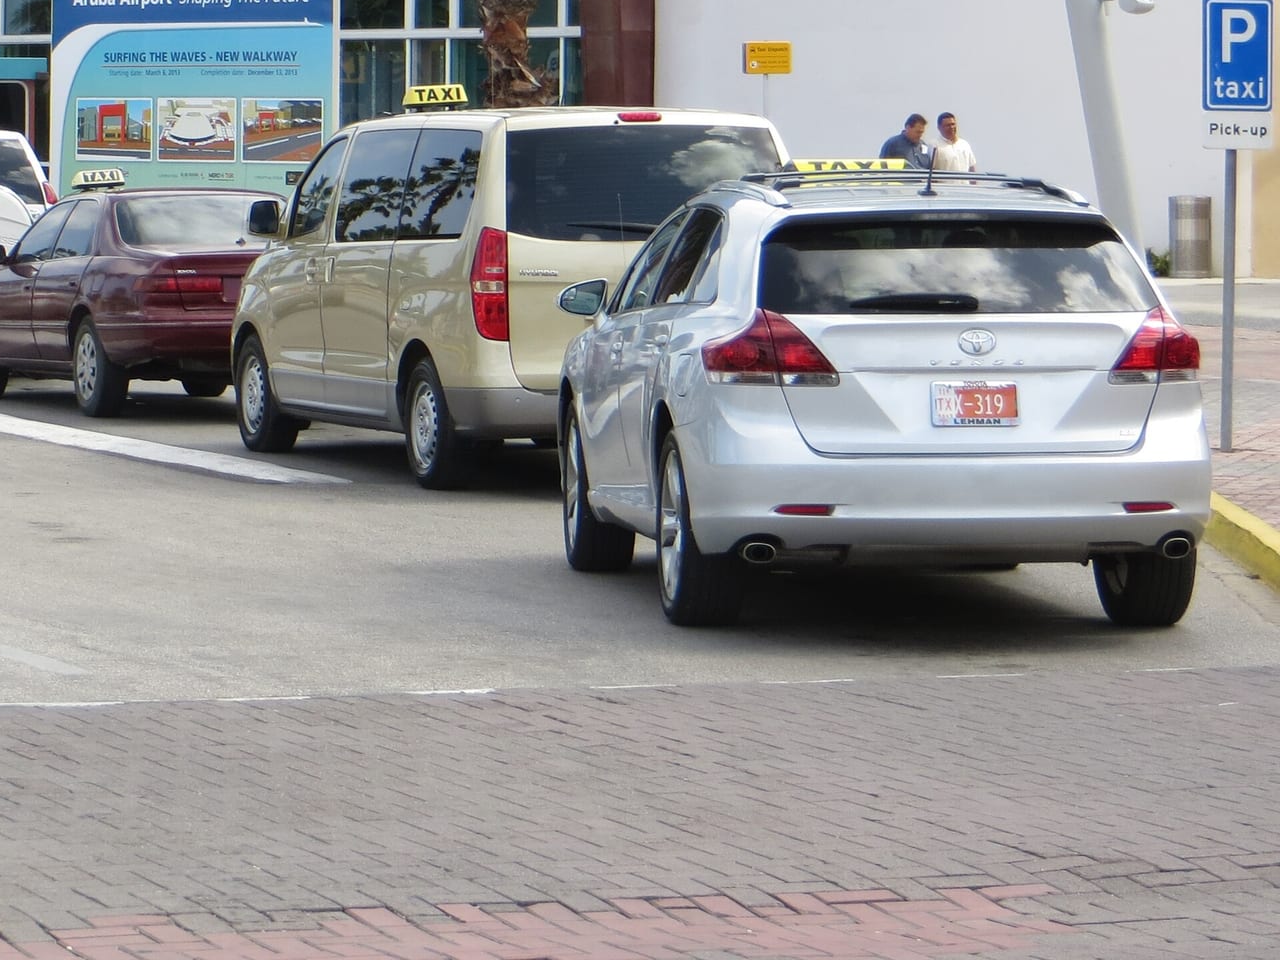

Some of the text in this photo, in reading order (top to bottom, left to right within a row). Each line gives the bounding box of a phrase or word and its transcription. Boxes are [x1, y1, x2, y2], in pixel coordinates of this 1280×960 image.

[1221, 8, 1257, 63] P
[103, 51, 147, 63] SURFING
[149, 51, 168, 62] THE
[170, 51, 206, 62] WAVES
[215, 50, 239, 62] NEW
[242, 50, 298, 62] WALKWAY
[145, 68, 161, 76] March
[247, 68, 274, 76] December
[1214, 76, 1265, 99] taxi
[414, 87, 462, 102] TAXI
[1209, 123, 1268, 138] Pick-up
[807, 160, 889, 172] TAXI
[83, 170, 120, 182] TAXI
[519, 268, 559, 277] HYUNDAI
[963, 380, 988, 388] TOYOTA
